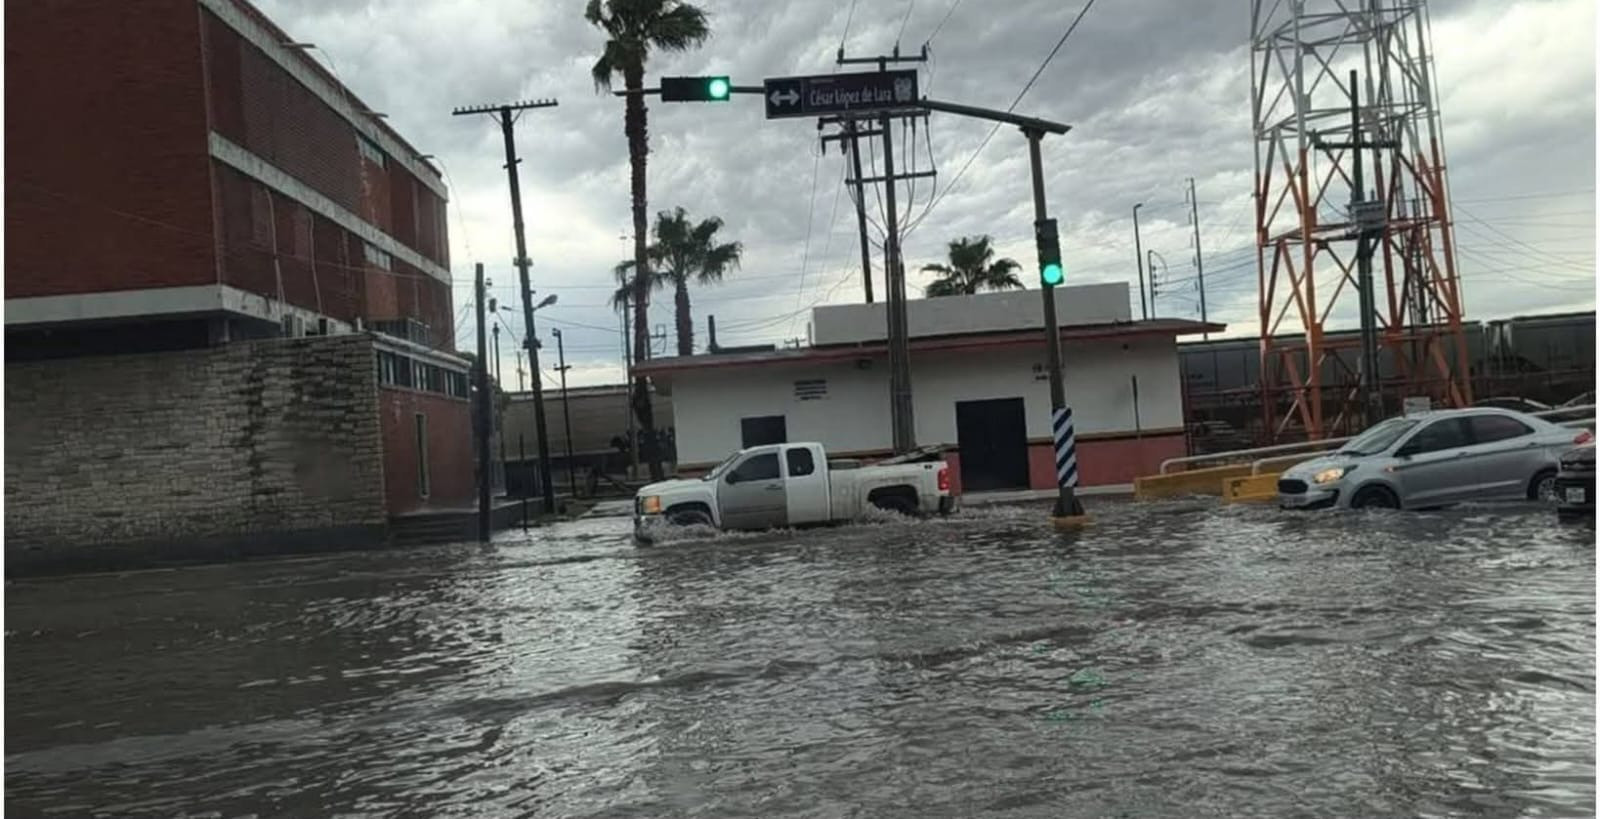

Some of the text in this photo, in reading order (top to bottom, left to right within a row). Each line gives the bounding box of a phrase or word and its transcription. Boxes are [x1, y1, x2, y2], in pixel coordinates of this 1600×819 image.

[809, 88, 833, 106] César
[861, 86, 872, 102] de
[874, 86, 892, 102] Lara
